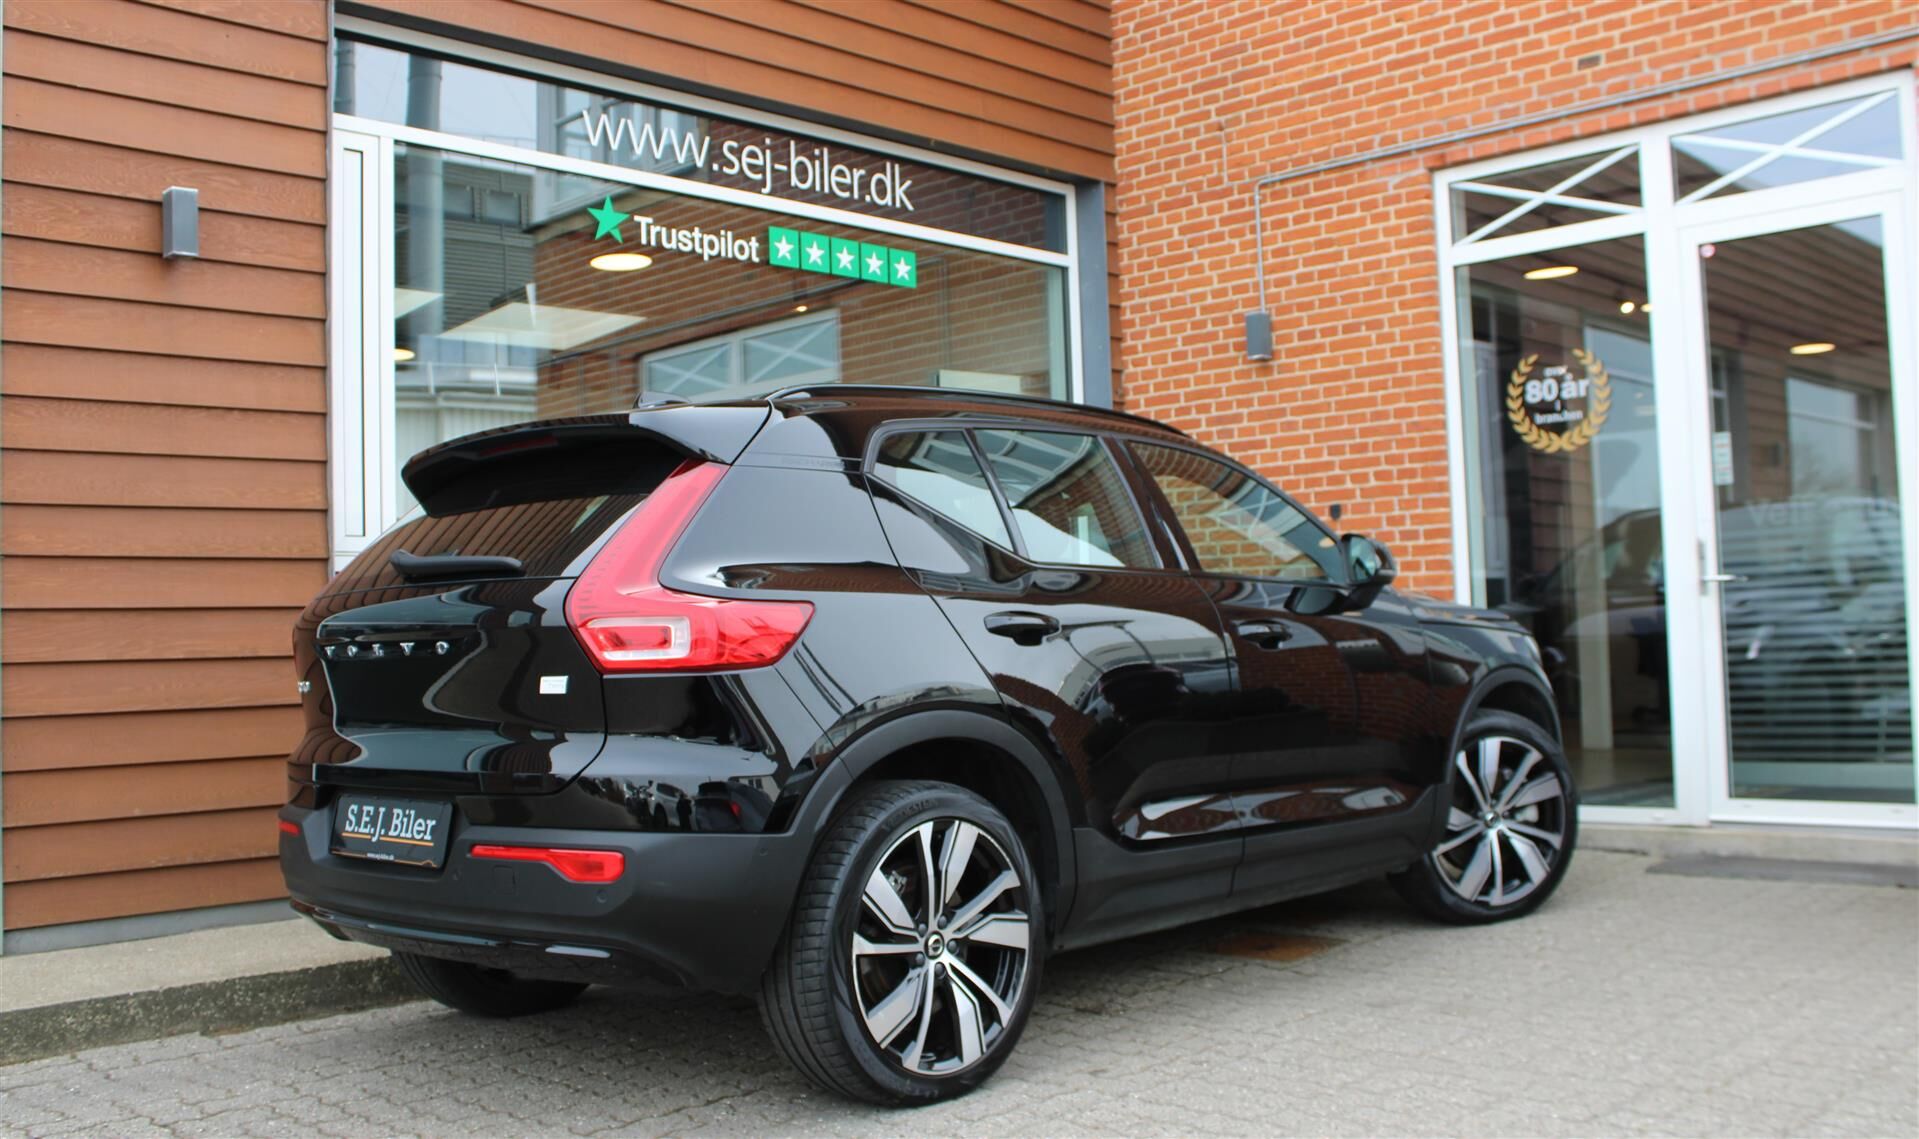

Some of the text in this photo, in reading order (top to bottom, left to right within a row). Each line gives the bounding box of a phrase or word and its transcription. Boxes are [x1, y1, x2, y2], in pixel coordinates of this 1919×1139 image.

[583, 110, 914, 211] www.sej-biler.dk
[633, 215, 759, 263] Trustpilot
[1525, 373, 1589, 403] 80 år
[345, 804, 436, 842] S.E.J. Biler
